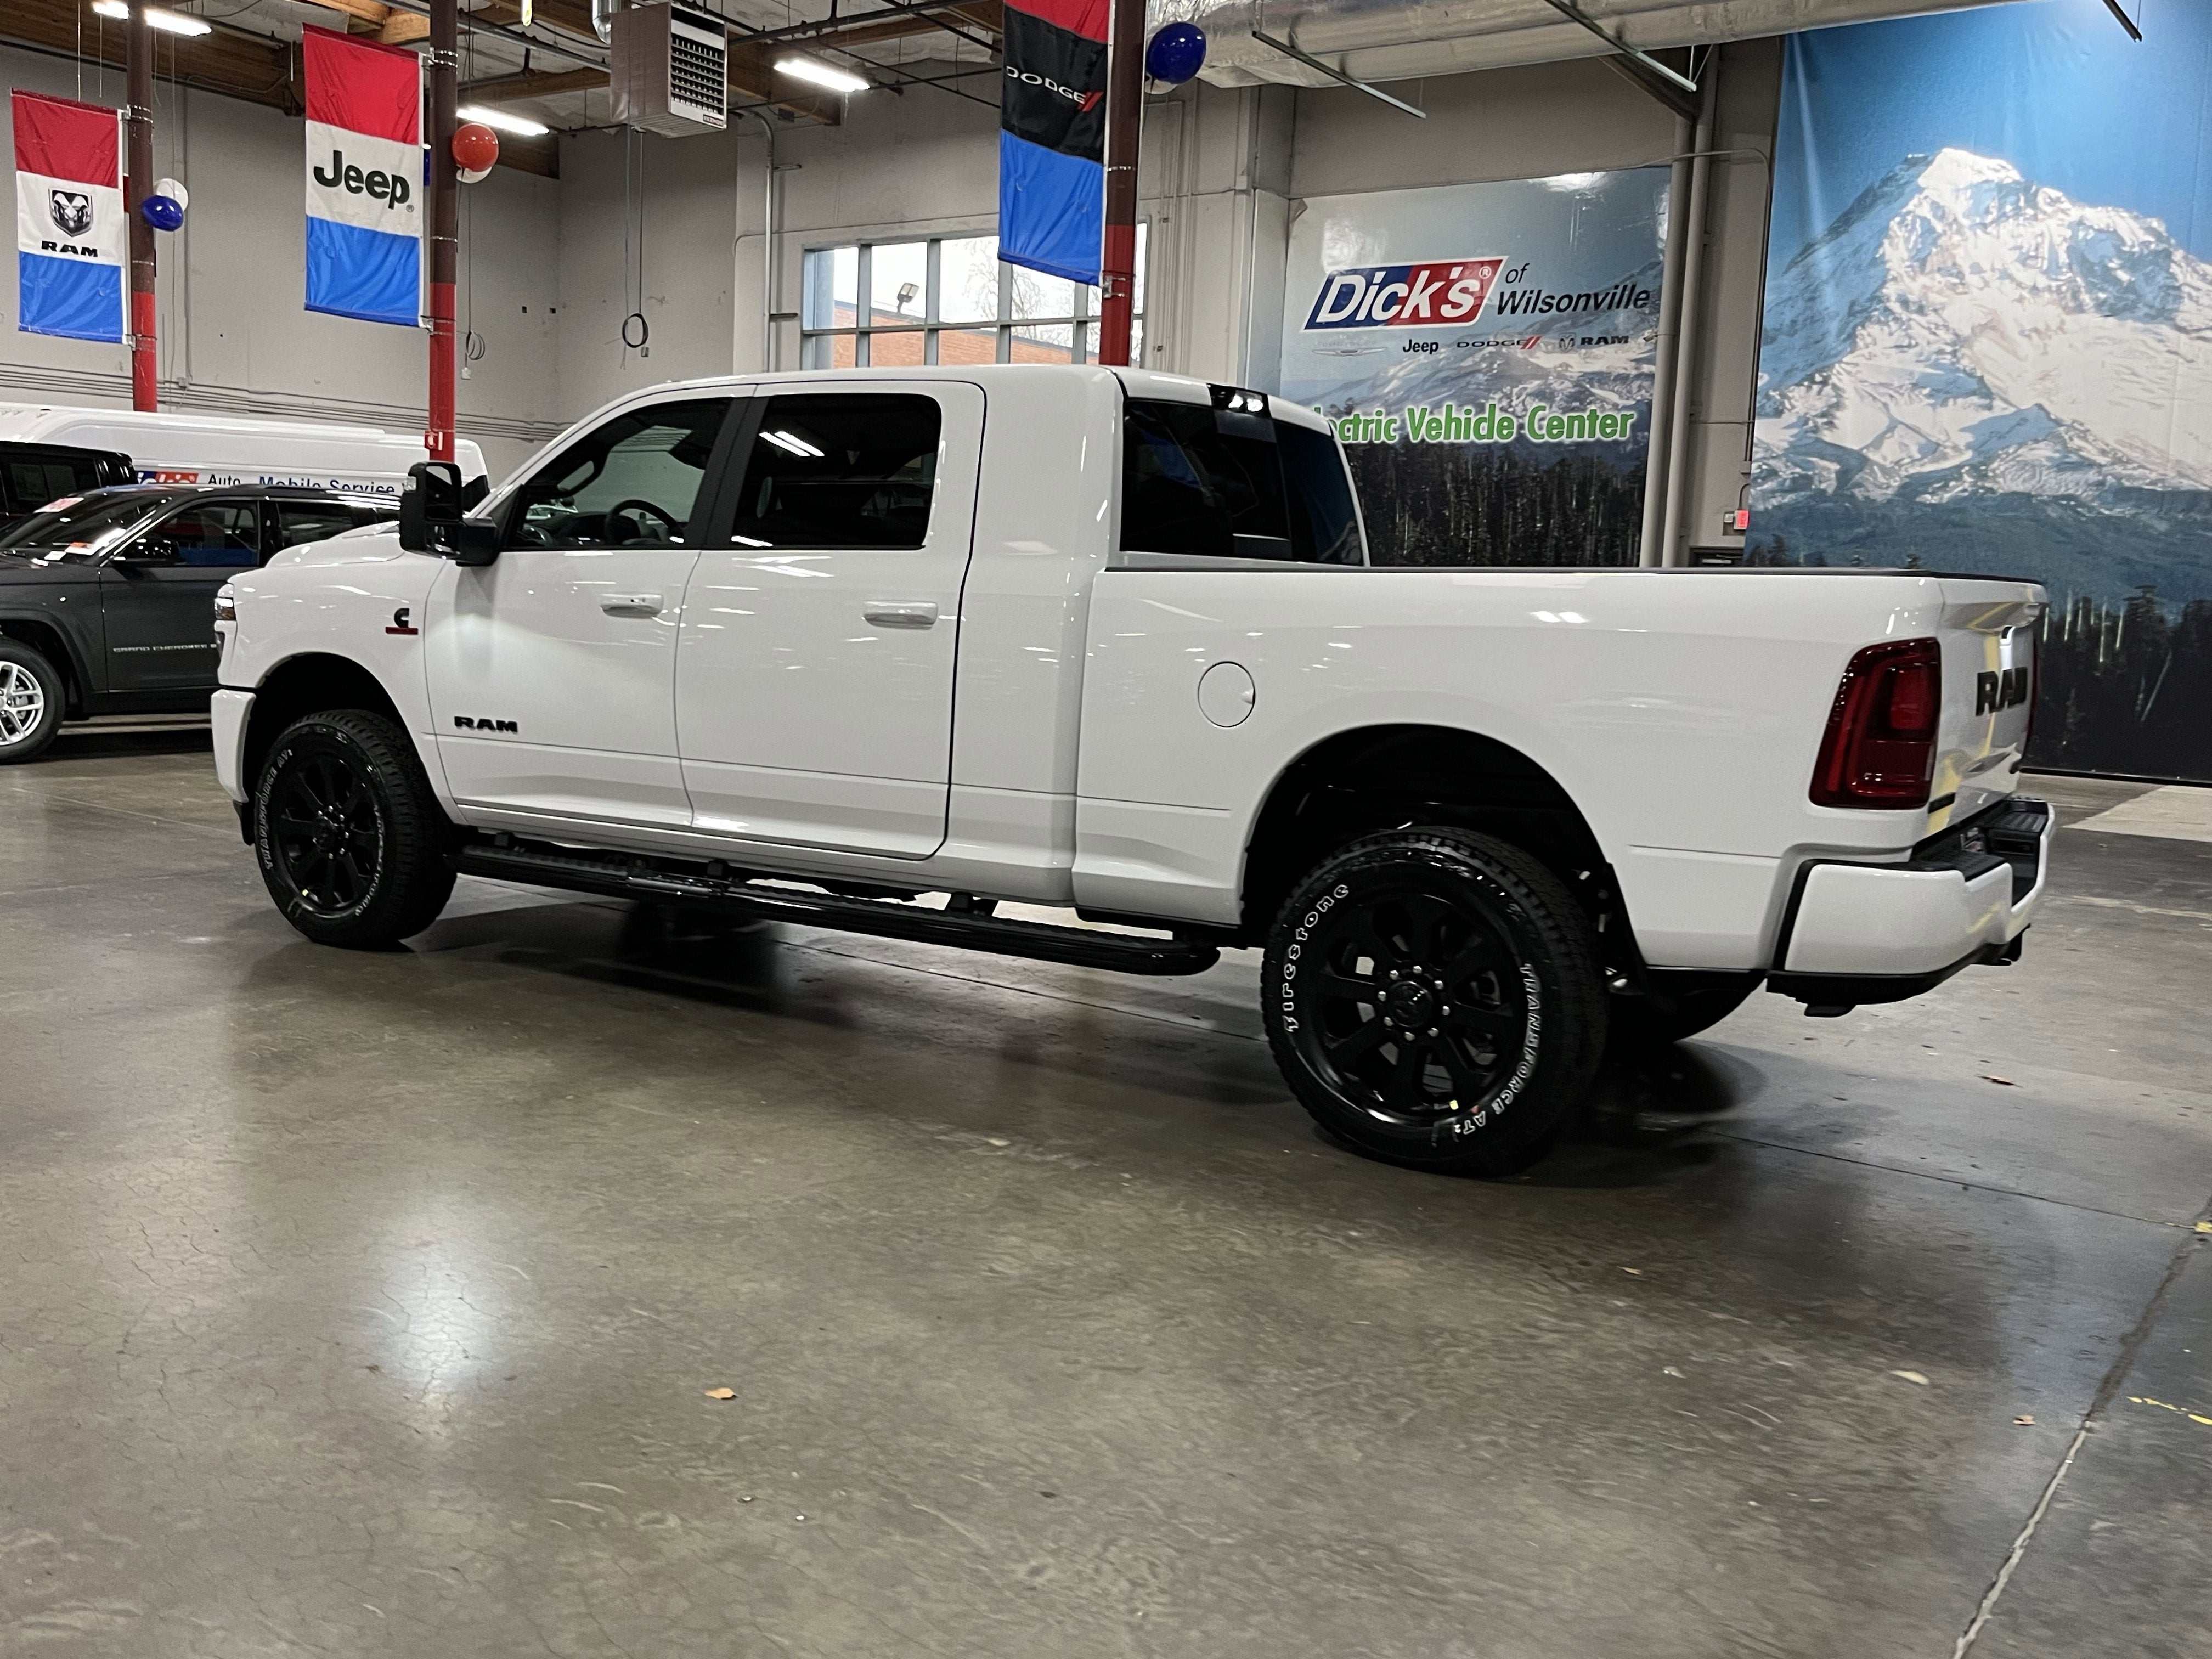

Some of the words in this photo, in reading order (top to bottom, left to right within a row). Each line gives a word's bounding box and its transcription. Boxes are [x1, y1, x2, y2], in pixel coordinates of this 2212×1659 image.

[1006, 65, 1086, 105] DODGE
[313, 150, 410, 210] Jeep
[41, 240, 98, 257] RAM
[1316, 267, 1480, 323] Dick's
[1505, 263, 1530, 284] of
[1497, 284, 1650, 315] Wilsonville
[1402, 339, 1439, 355] Jeep
[1580, 336, 1629, 346] RAM
[1314, 407, 1397, 441] ctric
[1407, 404, 1515, 441] Vehicle
[1527, 406, 1634, 441] Center
[454, 716, 517, 733] RAM
[1492, 963, 1541, 1115] TRANSFORCE
